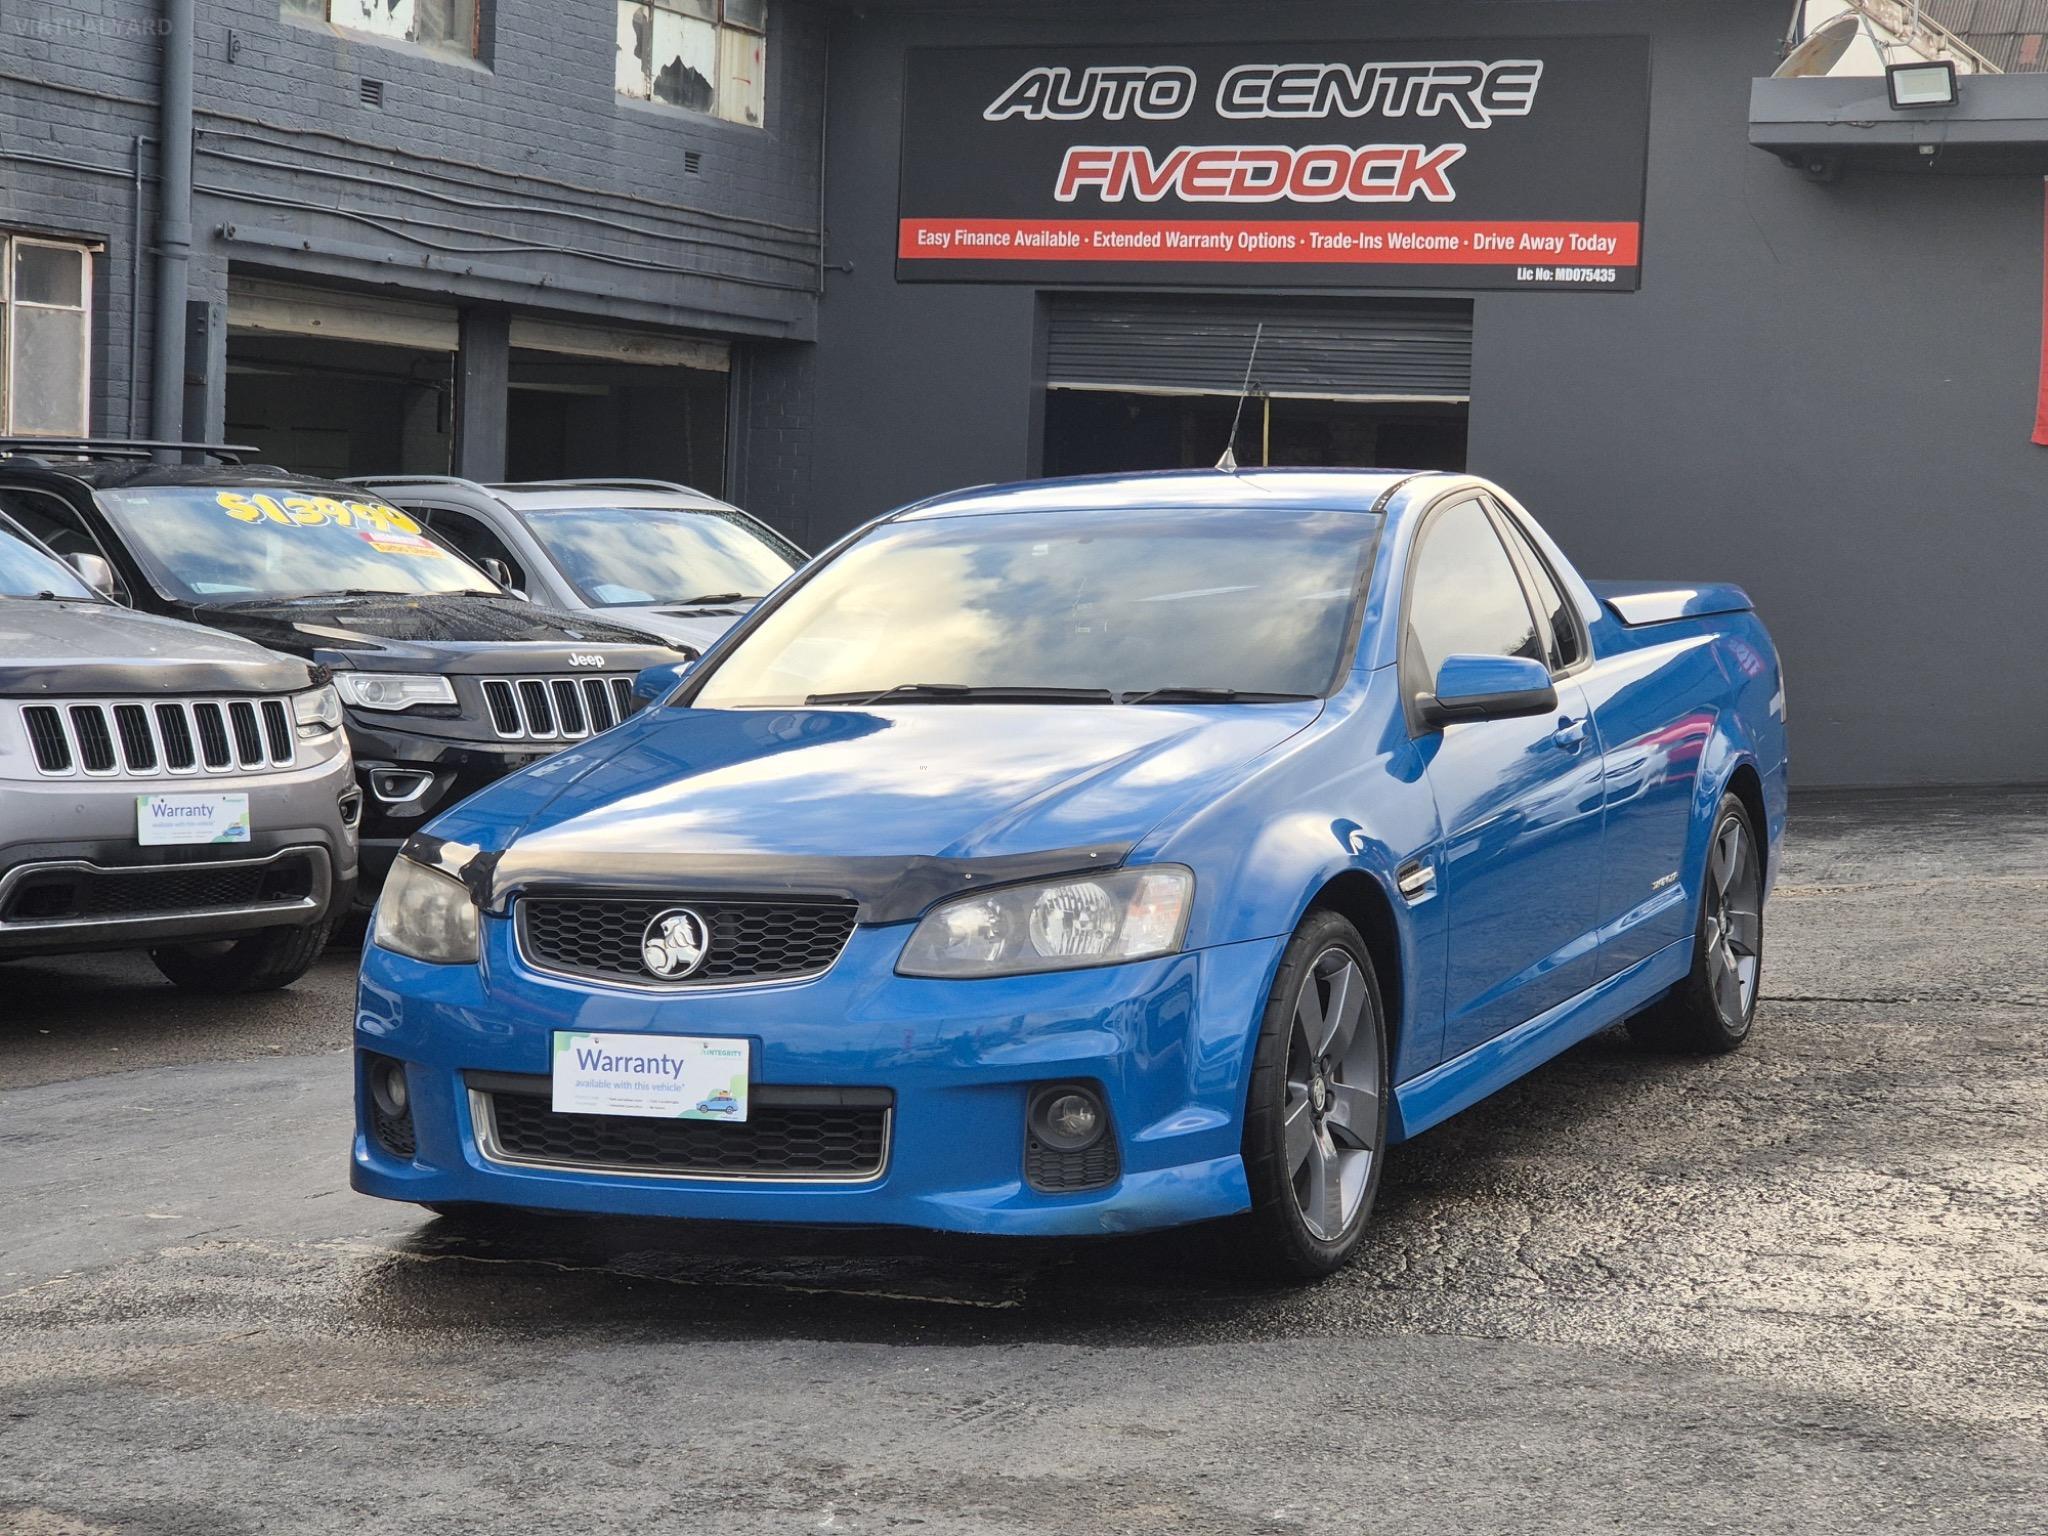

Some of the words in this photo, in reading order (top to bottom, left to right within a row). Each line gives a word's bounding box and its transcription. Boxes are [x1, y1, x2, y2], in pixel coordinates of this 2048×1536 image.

[983, 66, 1196, 121] AUTO
[1215, 59, 1543, 128] CENTRE
[1054, 143, 1466, 202] FIVEDOCK
[917, 229, 950, 248] Easy
[955, 229, 1010, 246] Finance
[1014, 230, 1080, 247] Available
[1093, 231, 1160, 248] Extended
[1166, 231, 1233, 251] Warranty
[1238, 231, 1296, 251] Options
[1310, 232, 1382, 249] Trade-Ins
[1387, 232, 1459, 249] Welcome
[1473, 232, 1514, 250] Drive
[1519, 233, 1564, 253] Away
[1569, 233, 1617, 254] Today
[1517, 267, 1533, 281] Lic
[1535, 267, 1553, 281] No:
[1555, 268, 1616, 282] MD075435
[216, 491, 421, 535] $13990
[568, 652, 605, 669] Jeep
[152, 803, 214, 818] Warranty
[576, 1048, 684, 1080] Warranty
[576, 1080, 611, 1090] available
[613, 1081, 632, 1091] with
[634, 1081, 650, 1091] this
